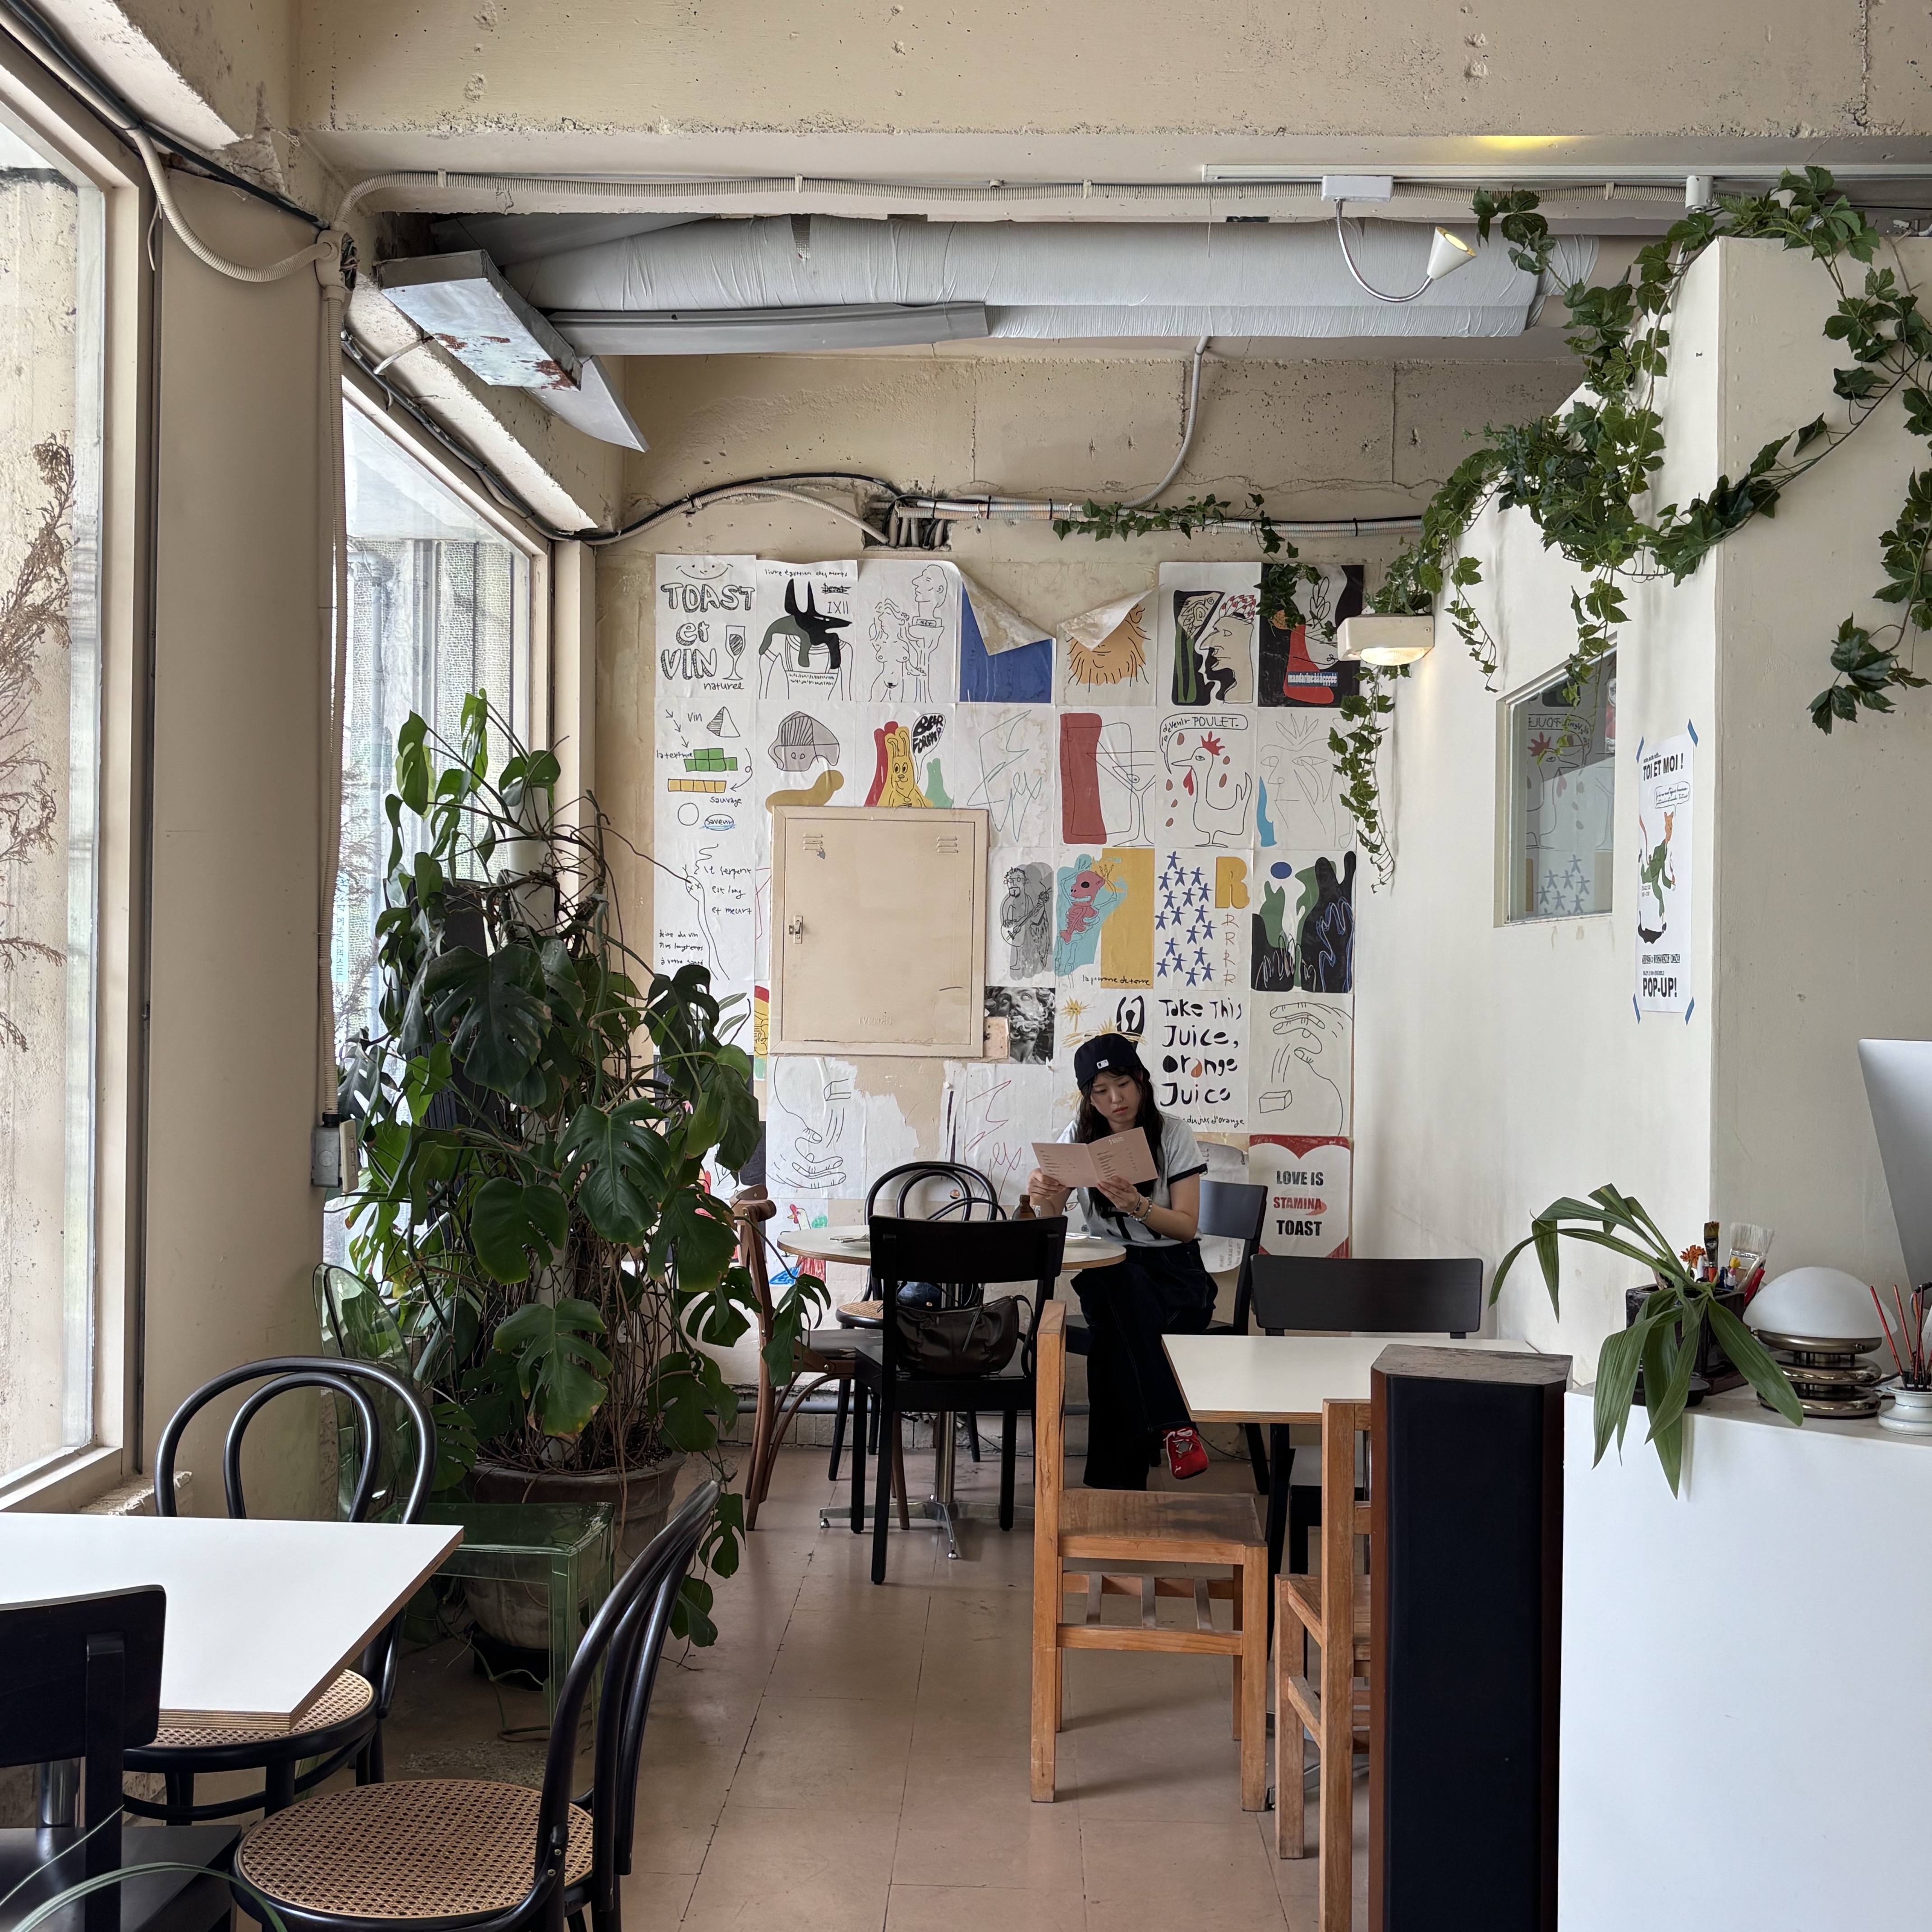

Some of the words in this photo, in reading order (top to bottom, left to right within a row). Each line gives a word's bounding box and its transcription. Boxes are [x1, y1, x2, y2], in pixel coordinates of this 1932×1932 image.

[660, 582, 755, 613] TOAST
[676, 621, 710, 646] et
[660, 648, 717, 680] VIN
[1643, 763, 1652, 781] TOI
[1653, 759, 1661, 777] ET
[1663, 754, 1678, 774] MOI
[1221, 912, 1239, 928] R
[1225, 932, 1235, 946] R
[1223, 949, 1236, 967] R
[1223, 969, 1236, 986] R
[1158, 998, 1204, 1017] Take
[1209, 997, 1242, 1020] This
[1160, 1082, 1231, 1107] Juice
[1276, 1170, 1307, 1185] LOVE
[1311, 1172, 1324, 1186] IS
[1273, 1196, 1322, 1210] STAMINA
[1276, 1219, 1322, 1236] TOAST
